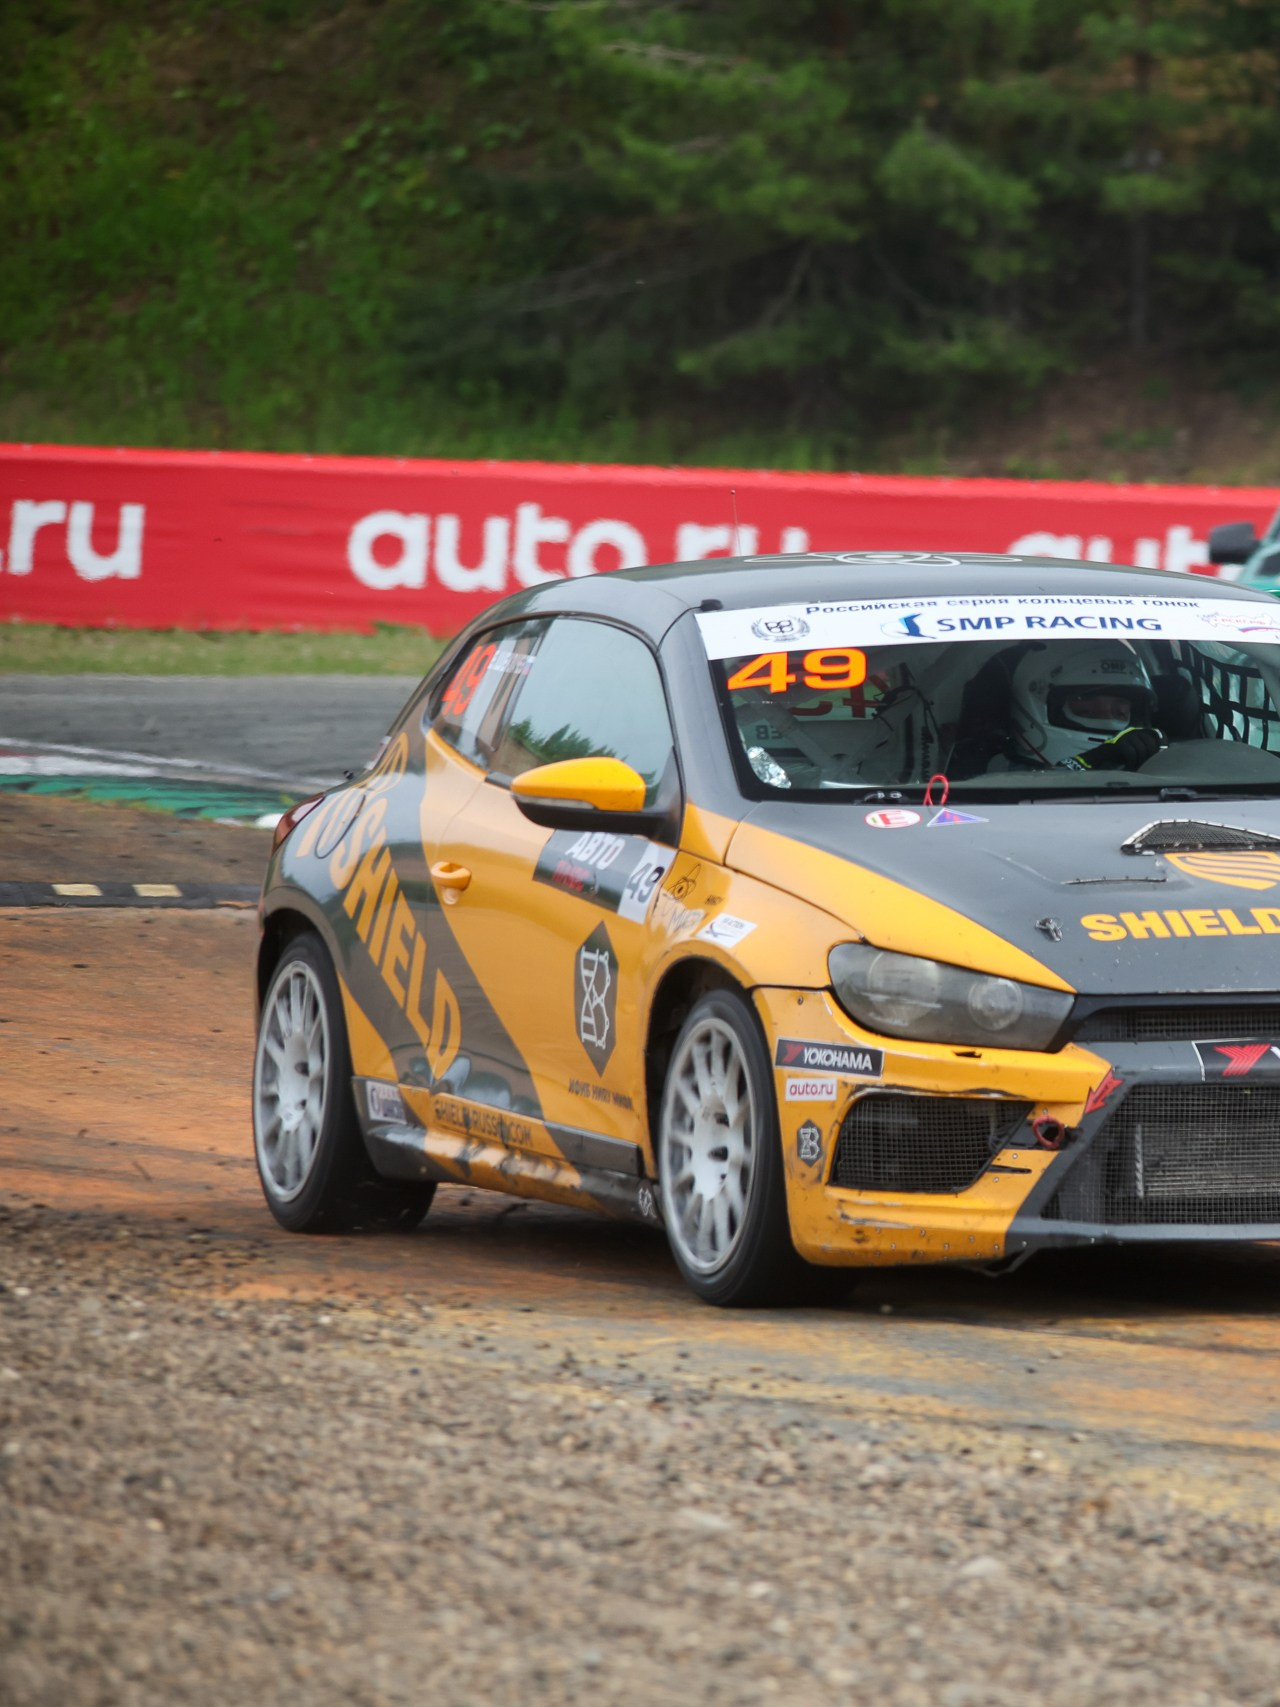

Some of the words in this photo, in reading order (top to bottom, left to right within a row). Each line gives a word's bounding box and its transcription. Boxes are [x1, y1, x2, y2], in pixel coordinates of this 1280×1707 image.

[0, 499, 146, 582] ru
[347, 503, 810, 593] autor
[806, 600, 938, 615] Российская
[946, 597, 1009, 609] серия
[1017, 597, 1134, 608] кольцевых
[1142, 599, 1200, 608] гонок
[937, 616, 1015, 632] SMP
[1025, 615, 1163, 632] RACING
[727, 647, 868, 693] 49
[803, 1046, 873, 1072] YOKOHAMA
[789, 1082, 835, 1097] auto.ru
